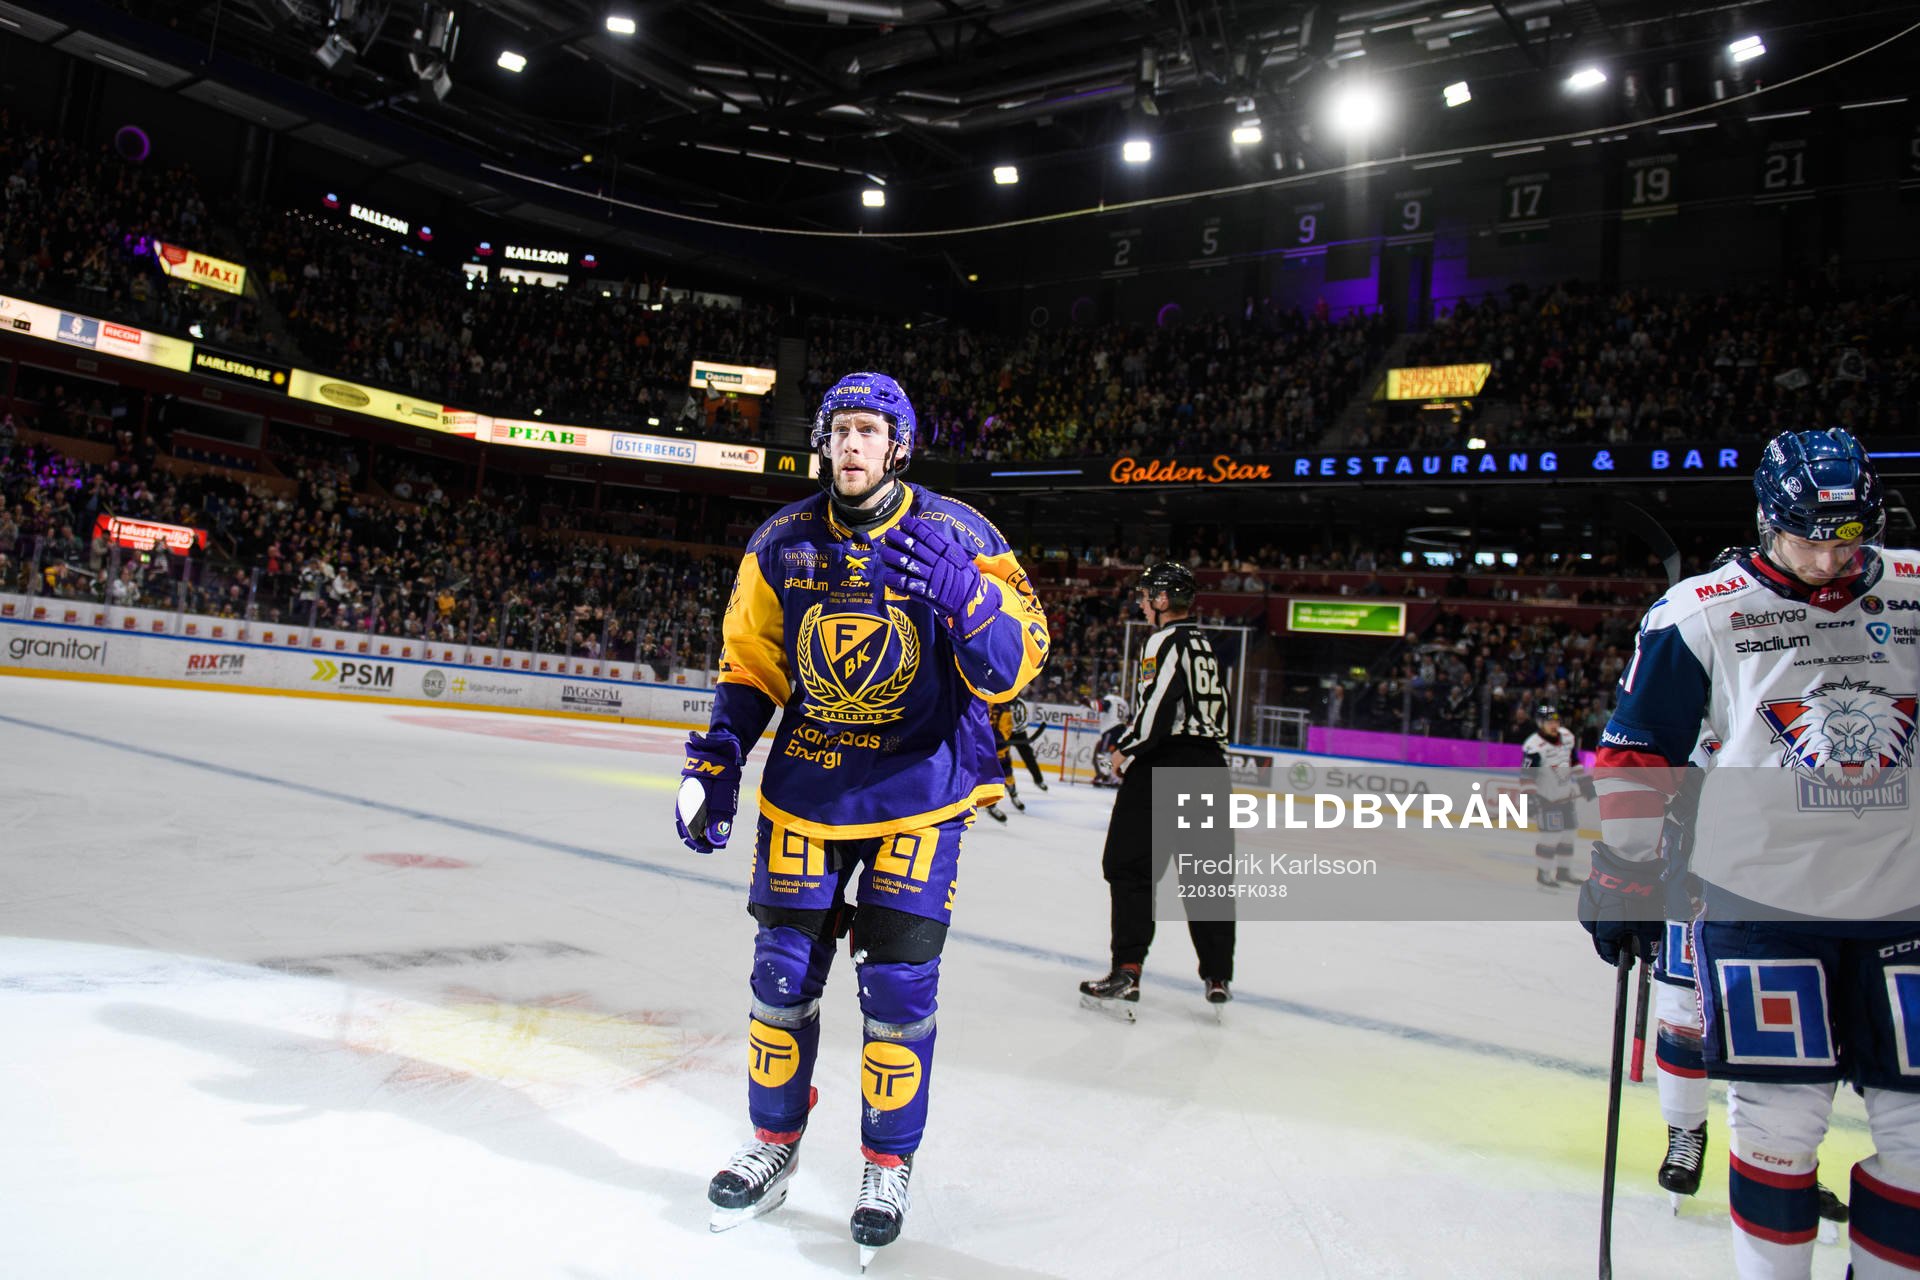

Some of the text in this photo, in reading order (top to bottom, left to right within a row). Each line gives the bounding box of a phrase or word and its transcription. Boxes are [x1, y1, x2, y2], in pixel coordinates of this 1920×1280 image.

[1764, 152, 1806, 189] 21
[1632, 167, 1671, 204] 19
[1509, 185, 1543, 218] 17
[351, 203, 409, 235] KALLZON
[1402, 201, 1421, 230] 9
[1202, 228, 1220, 255] 5
[1300, 215, 1316, 243] 9
[505, 245, 569, 265] KALLZON
[1114, 239, 1131, 266] 2
[196, 353, 271, 381] KARLSTAD.SE
[836, 386, 871, 395] KEWAB
[508, 426, 575, 445] PEAB
[1110, 455, 1272, 485] Golden Star
[1294, 449, 1739, 476] RESTAURANG & BAR
[1809, 525, 1835, 539] ÄT
[850, 542, 871, 551] SHL
[784, 577, 829, 591] stadium
[1695, 576, 1748, 599] MAXI
[1745, 608, 1807, 626] Botrygg
[1815, 620, 1856, 629] CCM
[9, 637, 101, 661] granitor
[835, 623, 858, 656] F
[1735, 635, 1811, 653] stadium
[844, 641, 872, 680] BK
[340, 662, 394, 688] PSM
[1194, 656, 1222, 695] 62
[821, 709, 883, 721] KARLSTAD
[1326, 768, 1431, 794] ŠKODA
[1808, 783, 1903, 806] LINKÖPING
[1752, 1151, 1793, 1166] CCM
